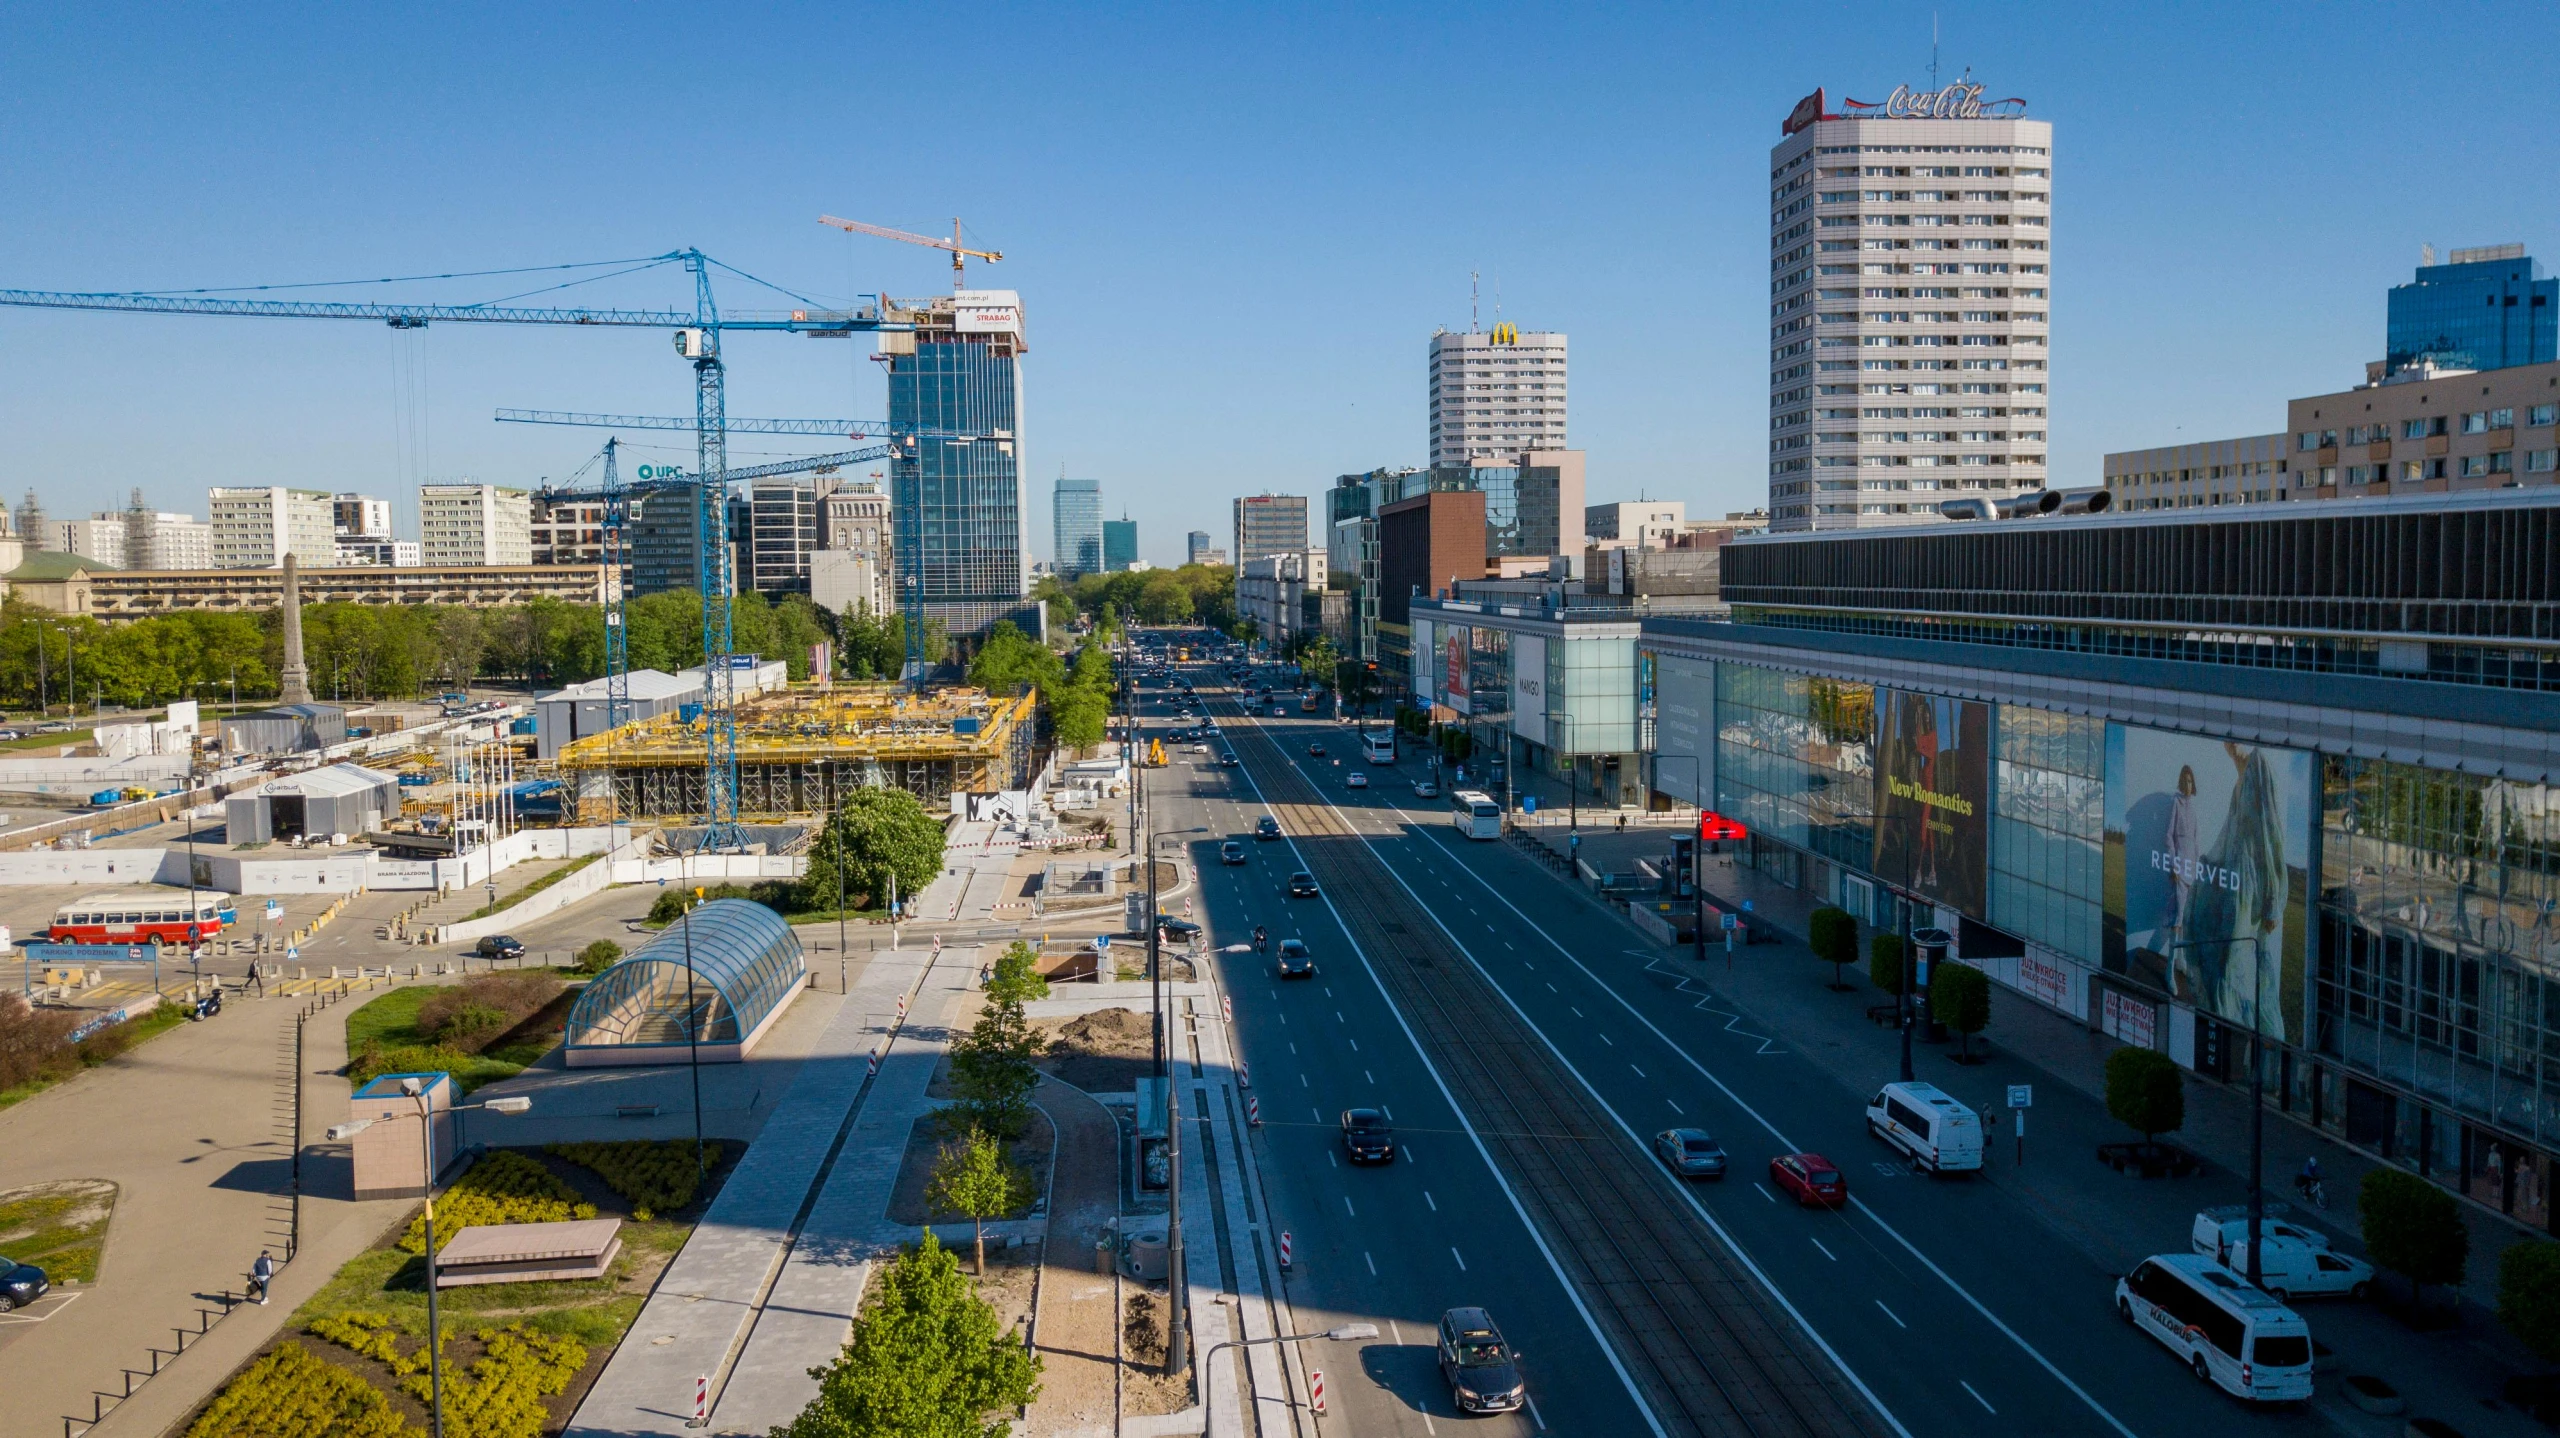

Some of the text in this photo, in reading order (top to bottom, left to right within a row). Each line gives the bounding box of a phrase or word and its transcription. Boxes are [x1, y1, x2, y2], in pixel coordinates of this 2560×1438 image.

[656, 465, 684, 479] UPC
[1519, 677, 1540, 697] MANGO
[1888, 775, 1973, 816] New Romantics
[2151, 849, 2240, 891] RESERVED
[2021, 956, 2067, 985] JUŻ WKRÓTCE
